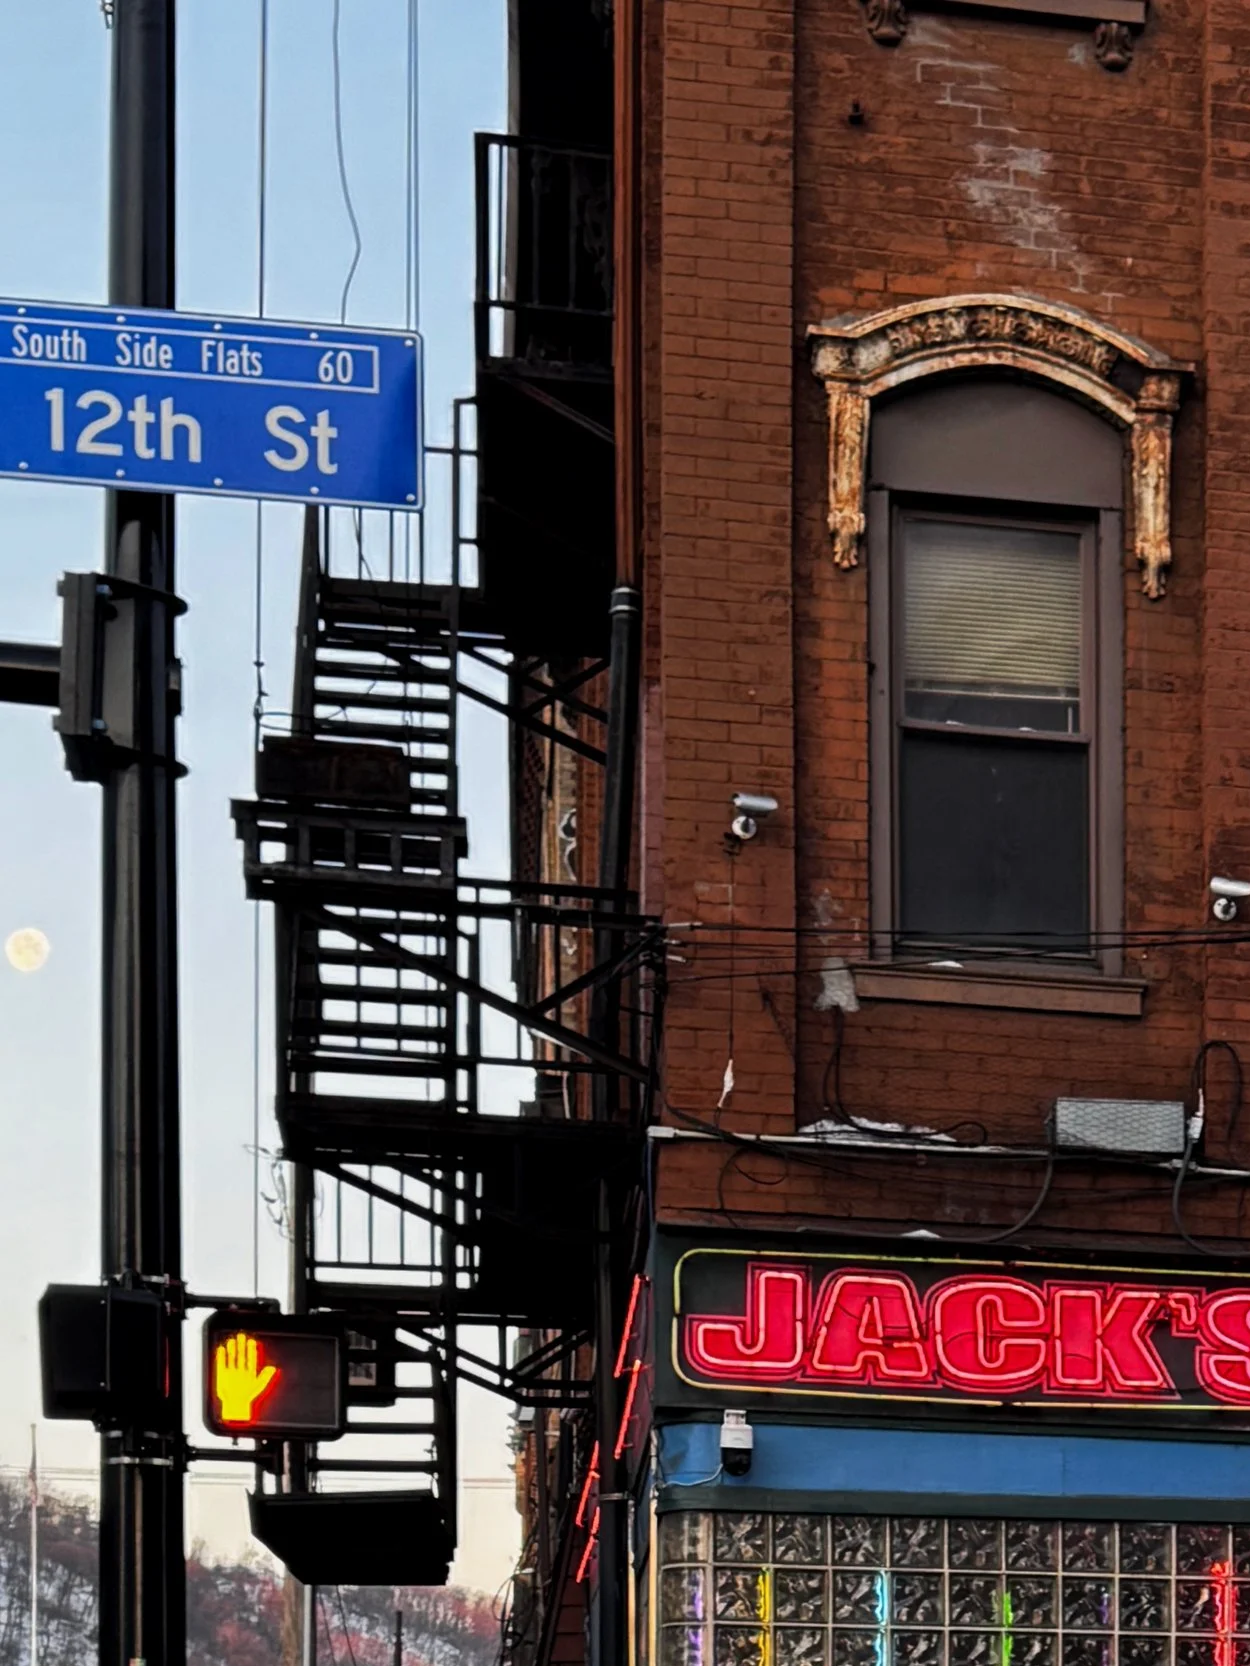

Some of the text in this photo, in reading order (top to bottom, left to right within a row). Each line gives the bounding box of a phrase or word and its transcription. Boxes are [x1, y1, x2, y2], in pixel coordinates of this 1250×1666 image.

[12, 325, 354, 384] South Side Flats 60
[44, 388, 338, 475] 12th St
